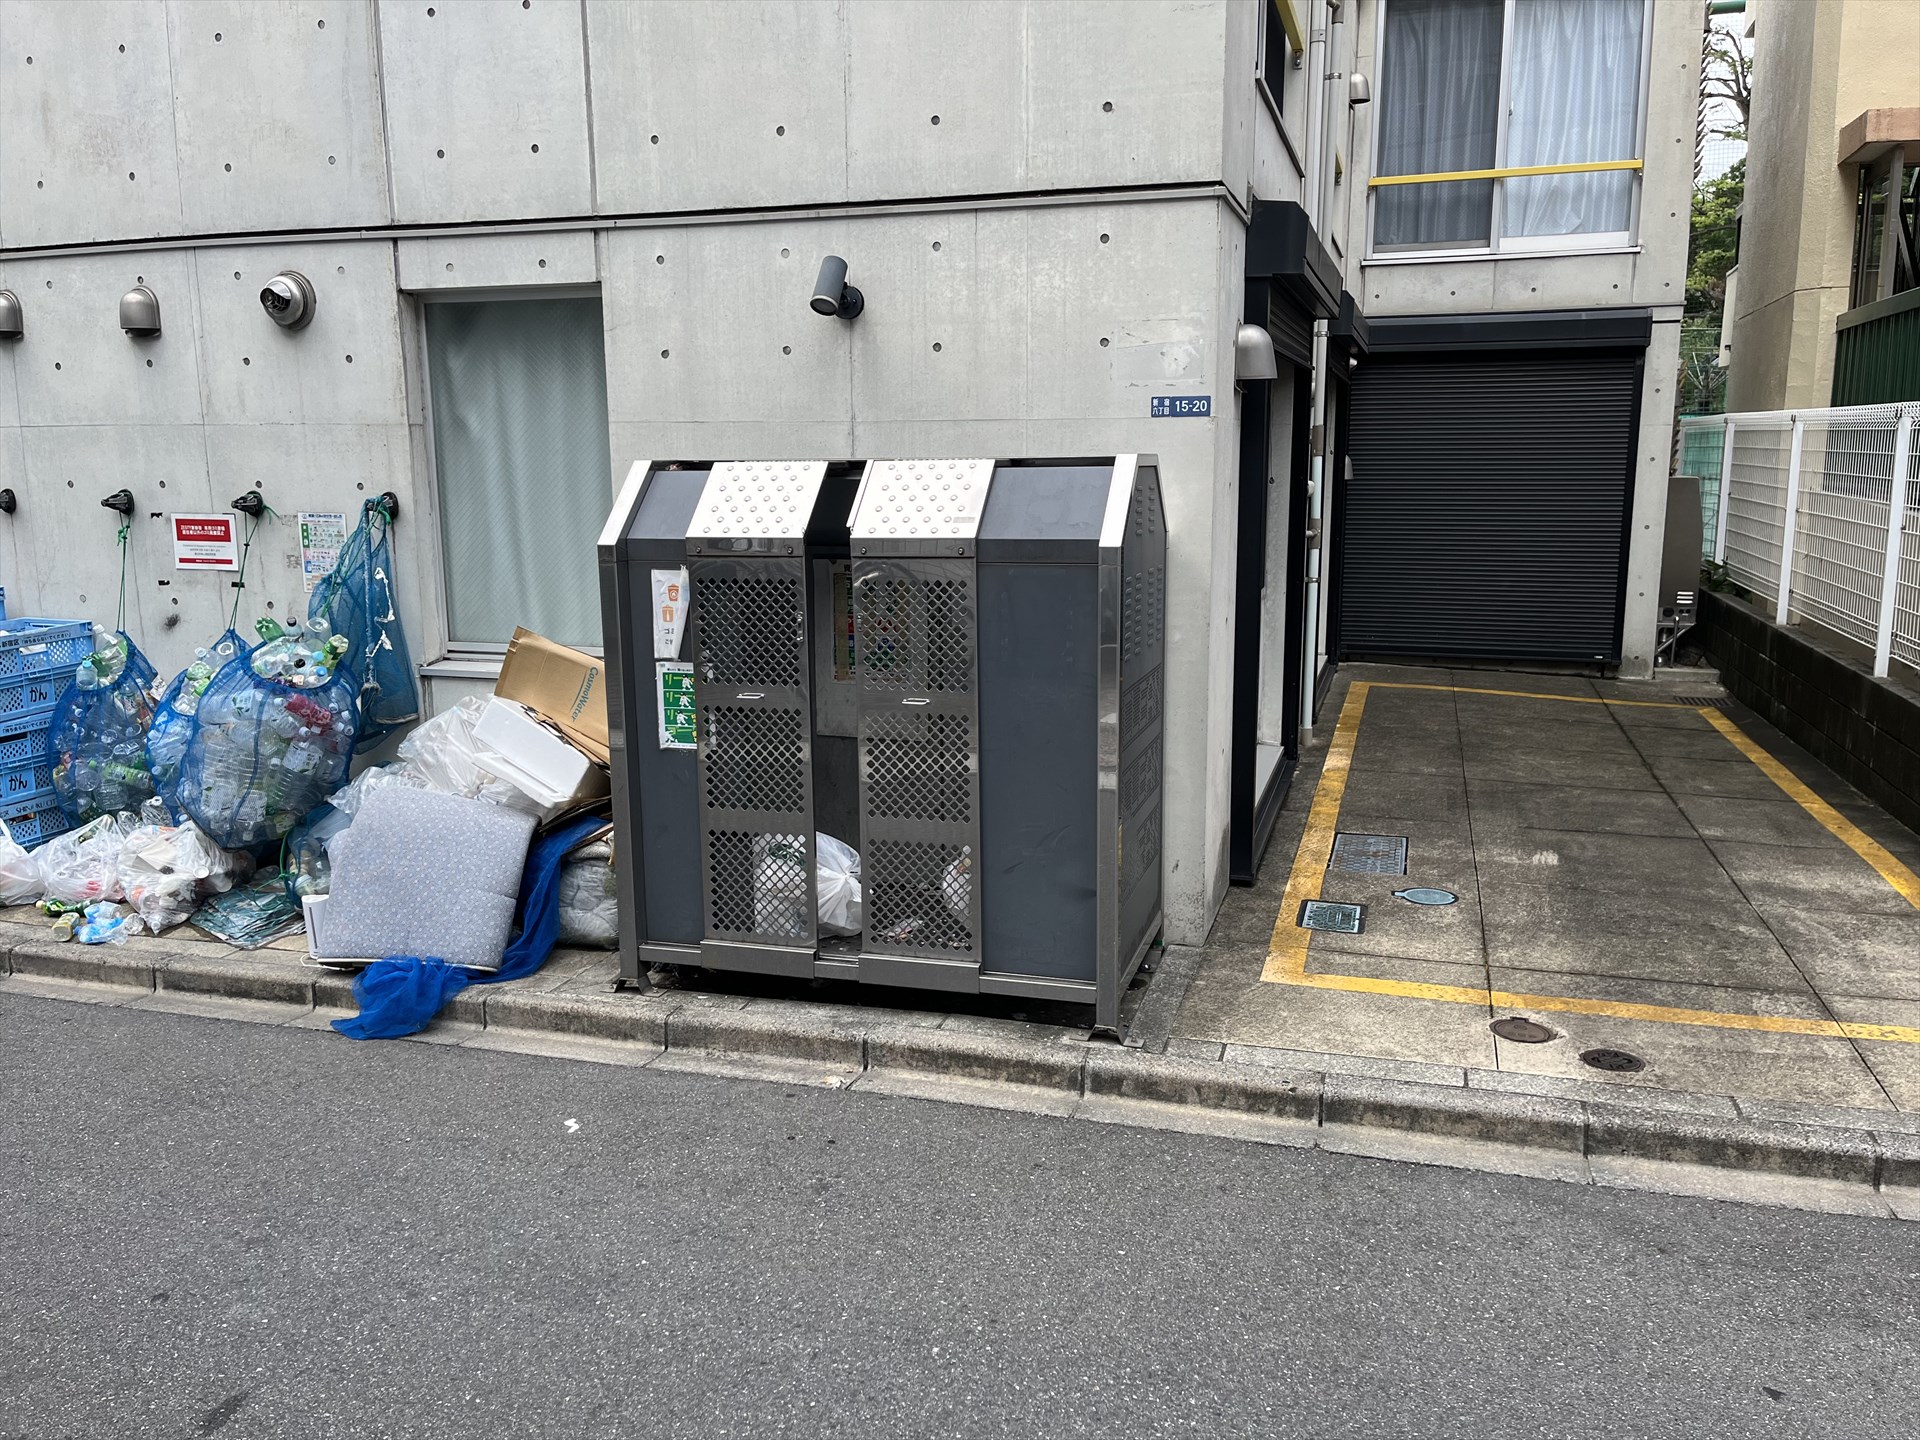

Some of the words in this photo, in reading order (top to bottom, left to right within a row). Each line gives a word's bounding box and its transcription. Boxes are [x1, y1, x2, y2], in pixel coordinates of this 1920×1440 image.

[1152, 407, 1170, 415] 六丁目
[1175, 400, 1208, 412] 15-20
[29, 687, 48, 702] かん
[571, 666, 598, 722] CosmoWater
[9, 773, 28, 791] かん
